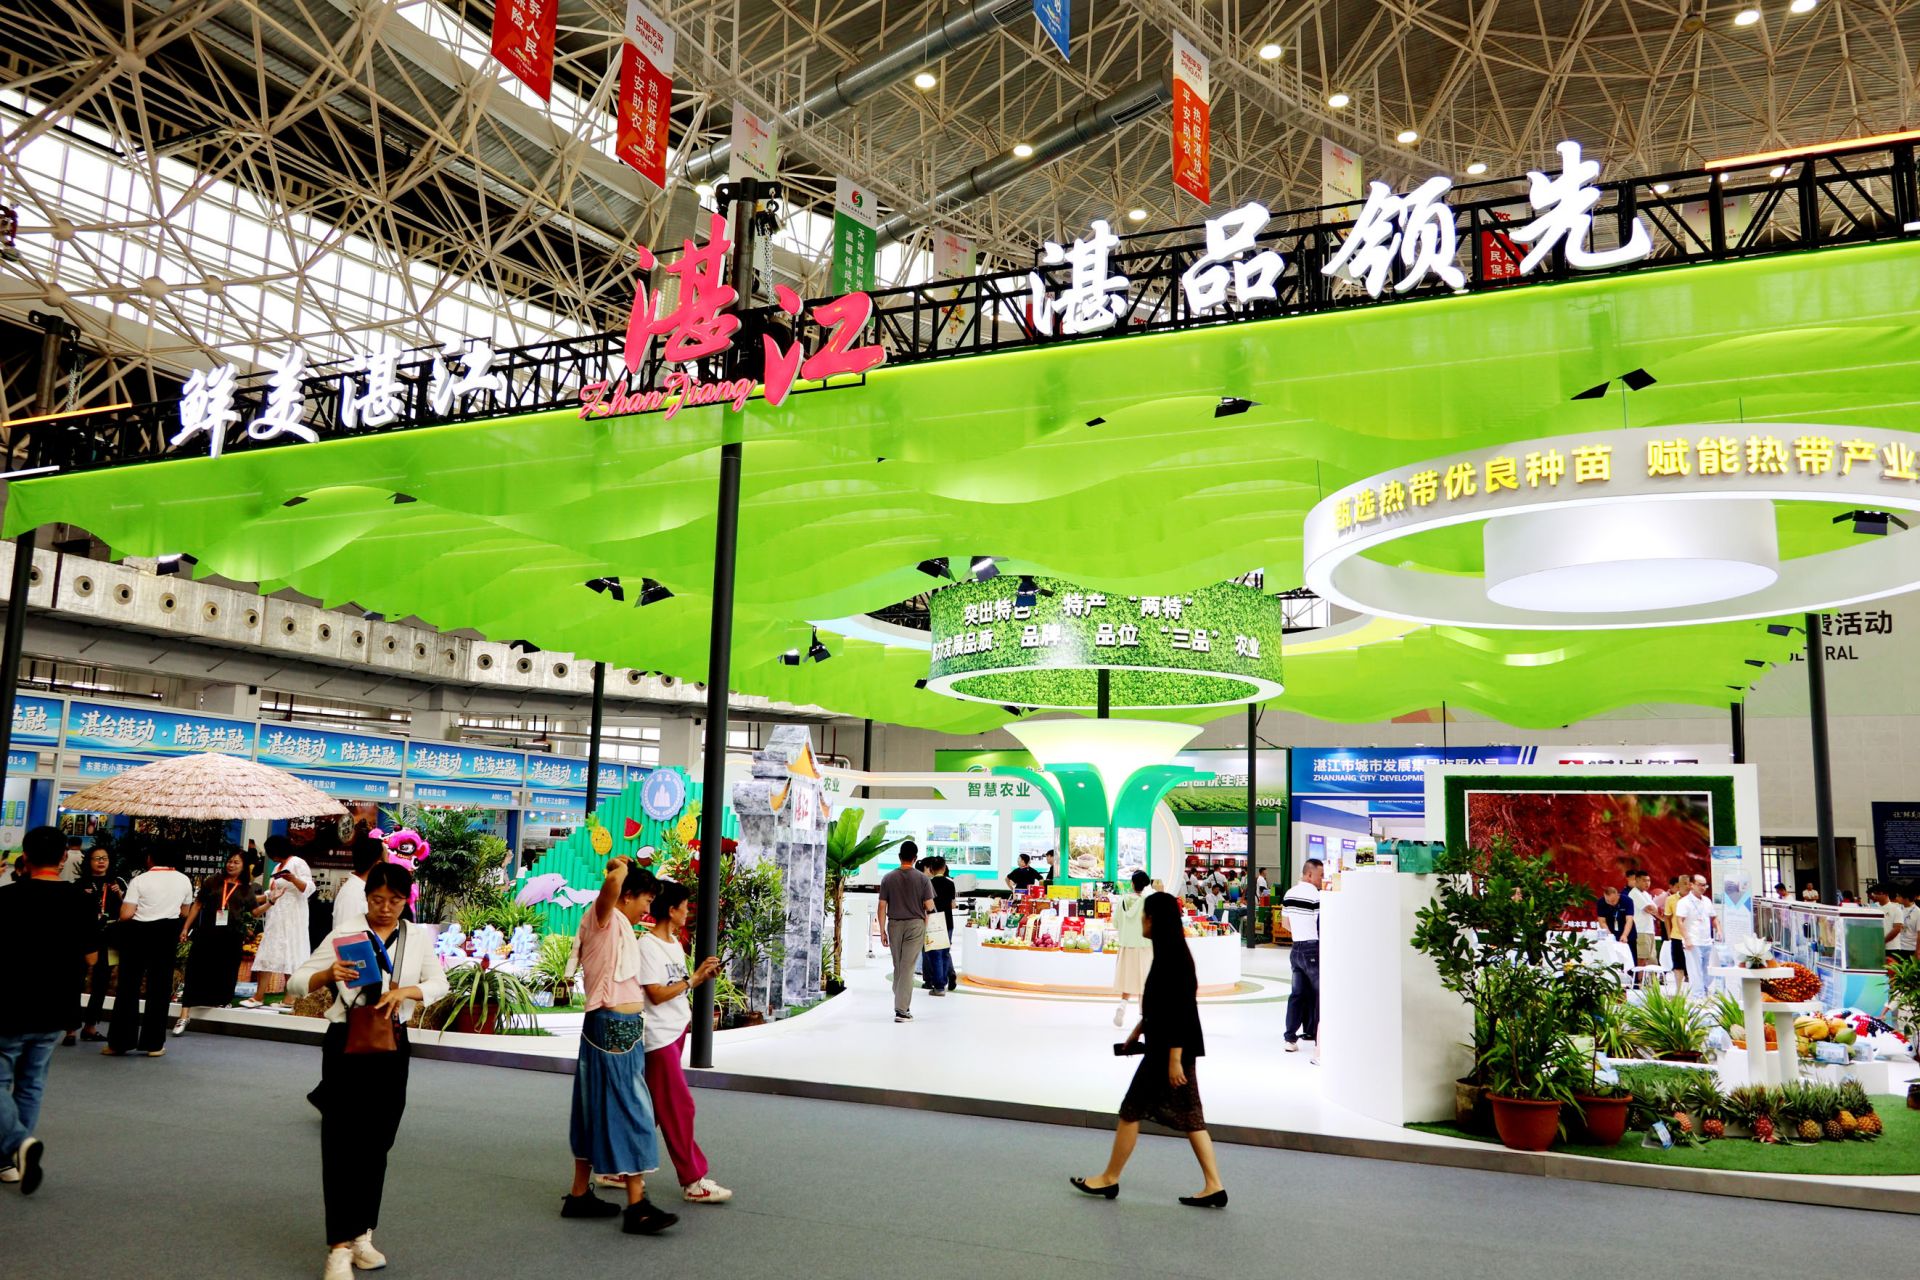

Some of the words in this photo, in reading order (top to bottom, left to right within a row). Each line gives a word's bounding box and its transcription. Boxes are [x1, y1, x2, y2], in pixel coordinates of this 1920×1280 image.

[632, 56, 646, 132] 平安助农
[1182, 88, 1191, 156] 平安助农
[1029, 141, 1653, 337] 湛品领先
[1489, 239, 1503, 280] 人民保
[624, 212, 887, 407] 湛江
[171, 337, 512, 459] 鲜美湛江
[1333, 445, 1612, 531] 甄选热带优良种苗
[1647, 435, 1918, 481] 赋能热带产业
[1063, 593, 1106, 616] 特产
[1096, 624, 1139, 646] 品位
[1234, 634, 1260, 658] 农业
[967, 782, 1031, 797] 智慧农业
[1255, 798, 1281, 807] A004
[1313, 774, 1356, 782] ZHANJIANG
[1360, 774, 1376, 782] CITY
